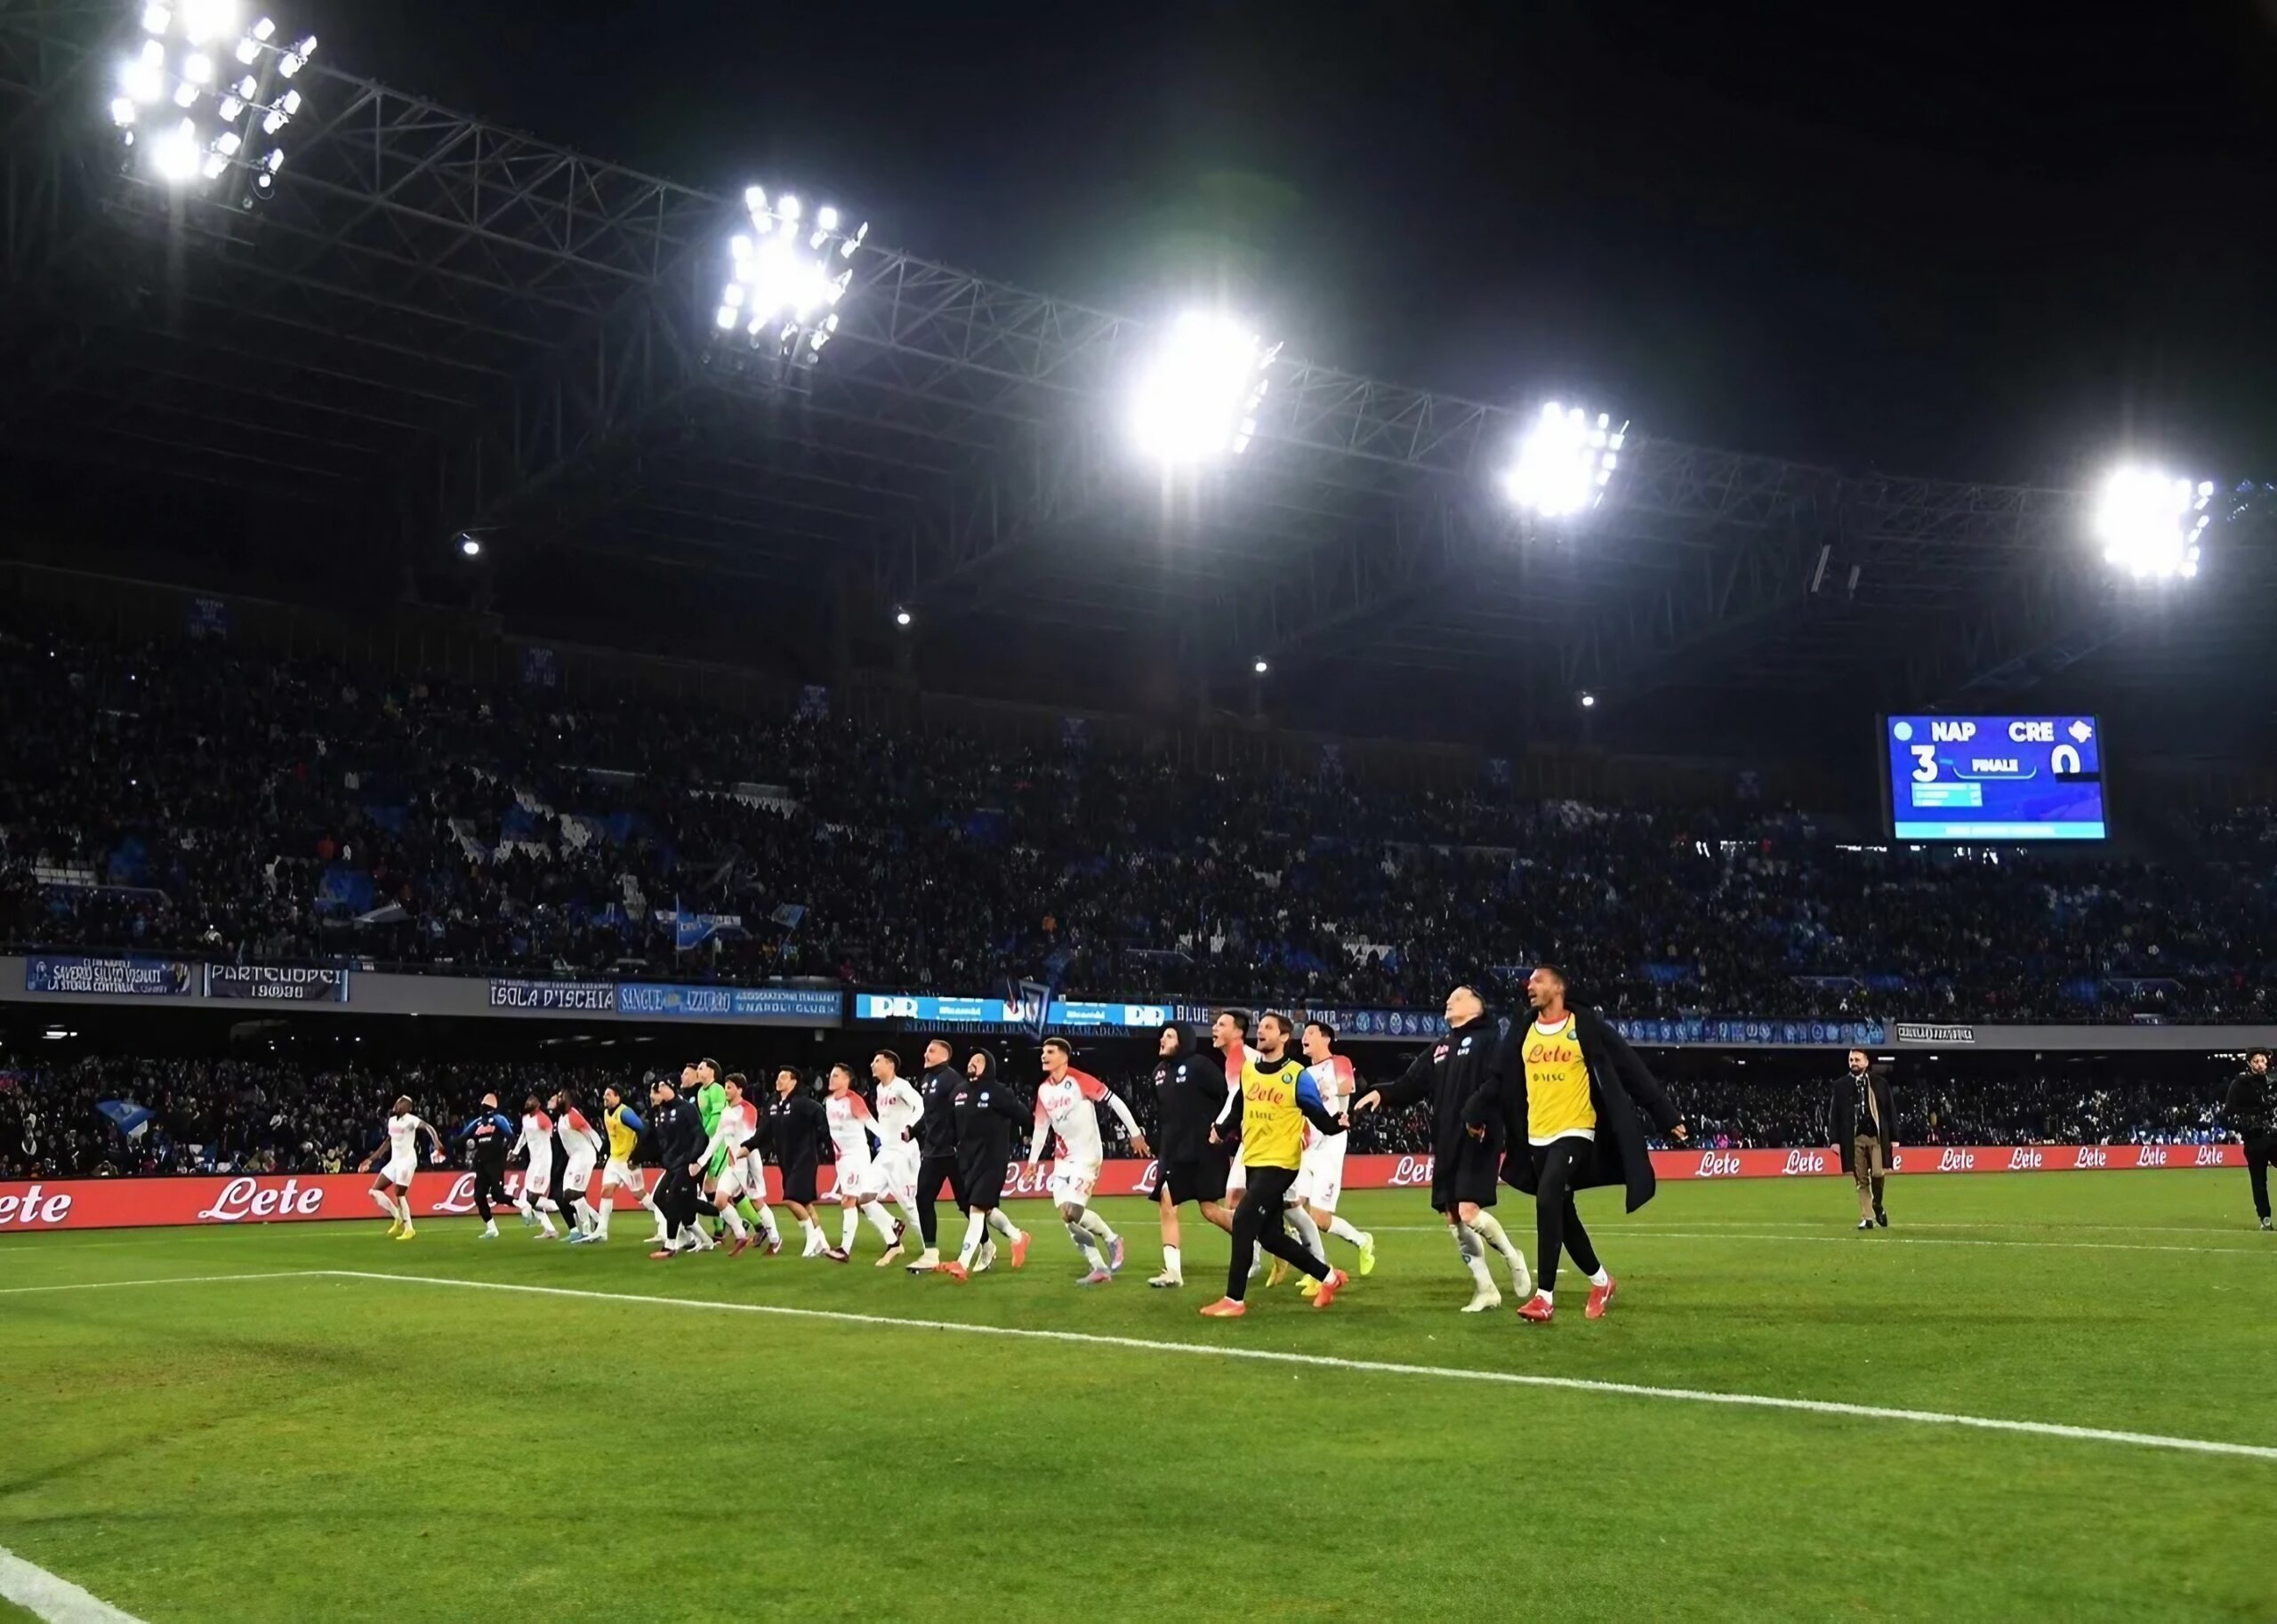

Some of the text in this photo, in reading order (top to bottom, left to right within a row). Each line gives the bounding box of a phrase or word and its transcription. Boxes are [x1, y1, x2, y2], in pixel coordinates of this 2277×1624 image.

[1931, 721, 2055, 743] NAP CRE
[1911, 744, 2081, 783] 3 0
[491, 986, 614, 1009] ISOLA D'ISCHIA
[621, 987, 664, 1011] SANGUE
[1176, 1004, 1209, 1023] BLUE
[1527, 1043, 1572, 1064] Lete
[1245, 1081, 1283, 1105] Lete
[1695, 1151, 1741, 1177] Lete
[1782, 1149, 1824, 1175] Lete
[1937, 1147, 1975, 1171] Lete
[2007, 1146, 2042, 1170] Lete
[2074, 1146, 2106, 1168] Lete
[2136, 1145, 2168, 1167] Lete
[1388, 1155, 1435, 1186] Let
[0, 1185, 72, 1224] ete
[197, 1177, 324, 1221] Lete
